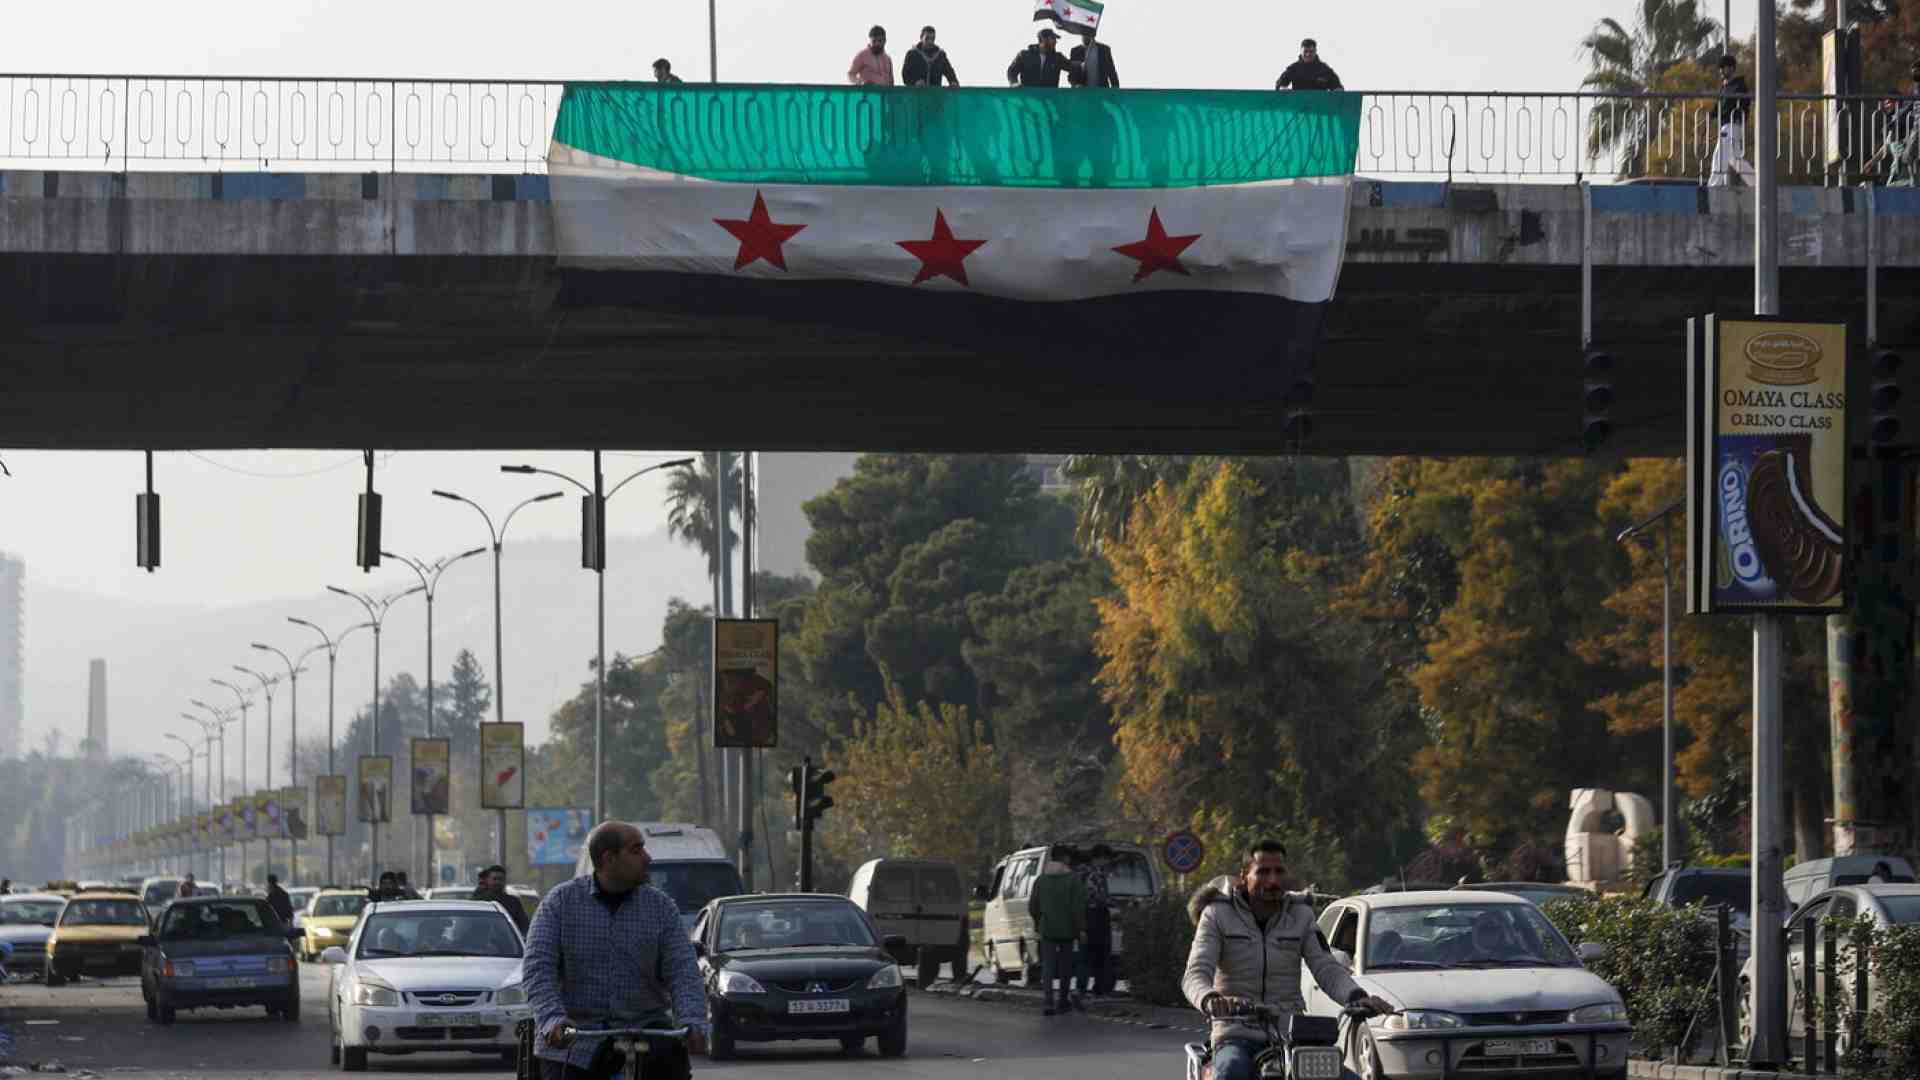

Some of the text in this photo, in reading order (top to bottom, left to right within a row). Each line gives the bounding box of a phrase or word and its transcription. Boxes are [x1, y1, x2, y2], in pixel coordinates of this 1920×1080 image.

[1723, 389, 1846, 409] OMAYA CLASS
[1789, 415, 1832, 429] CLASS
